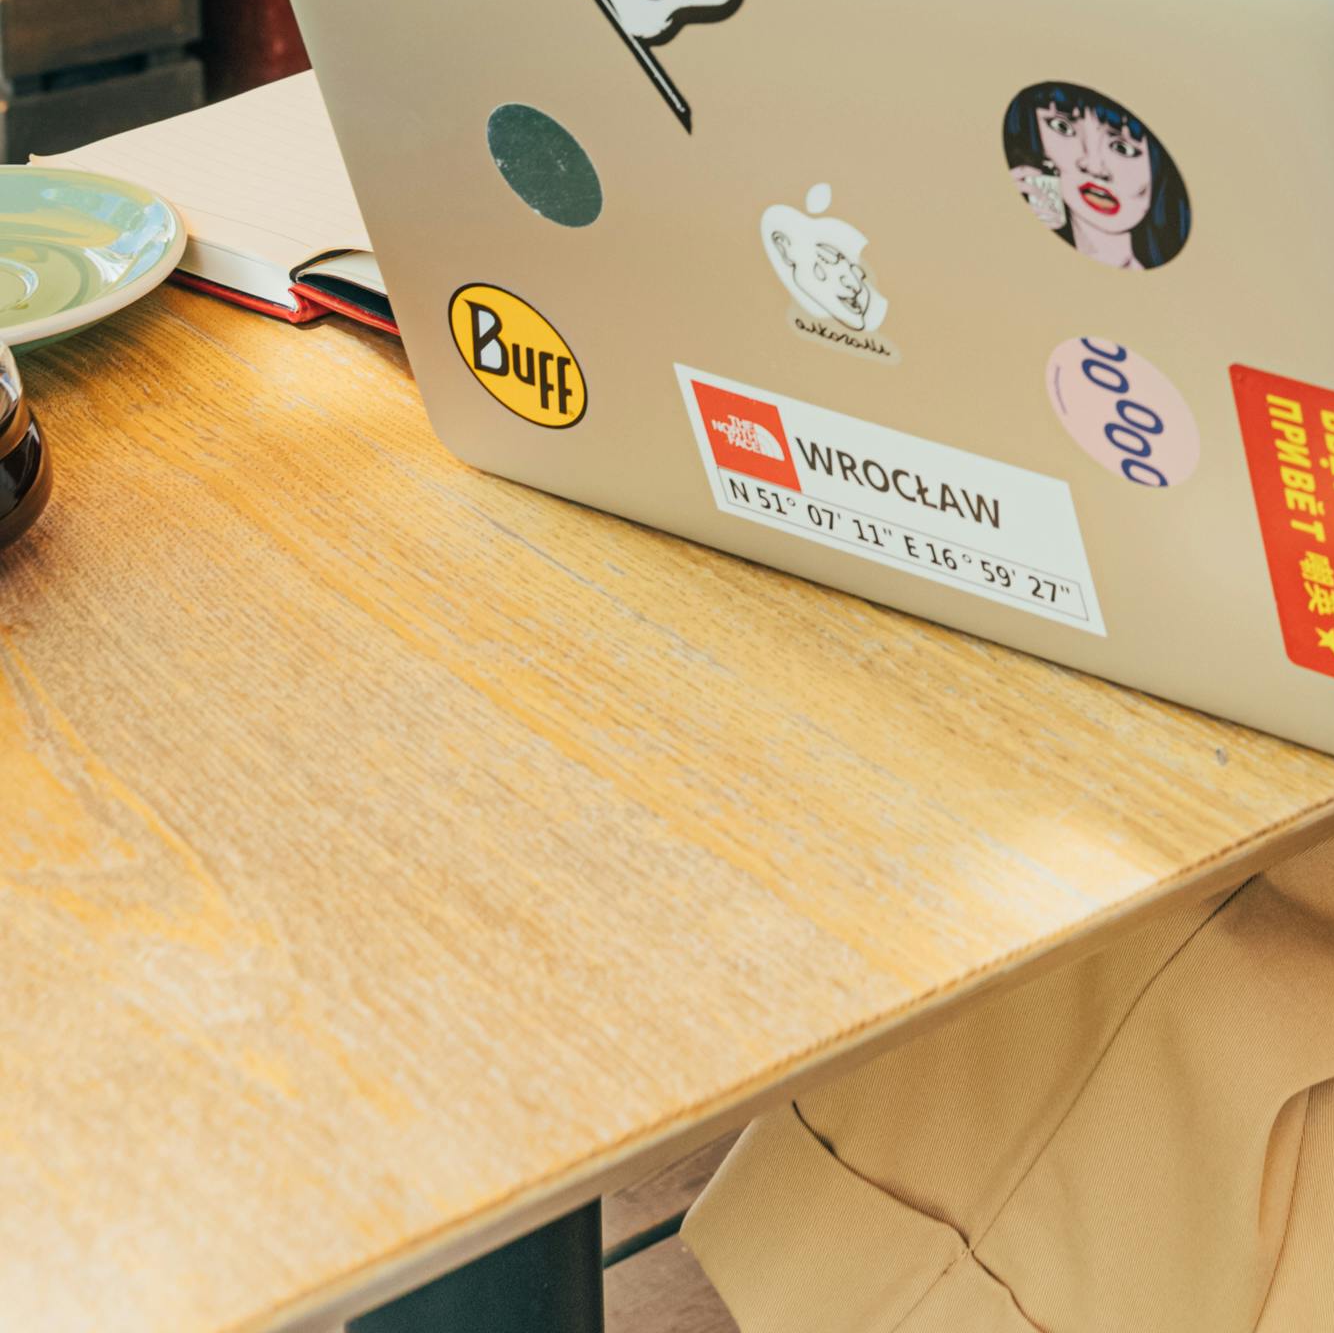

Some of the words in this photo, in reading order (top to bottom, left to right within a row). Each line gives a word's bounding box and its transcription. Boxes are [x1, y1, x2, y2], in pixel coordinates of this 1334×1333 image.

[729, 478, 750, 504] N
[756, 487, 796, 516] 51°
[904, 535, 921, 559] E
[796, 437, 1000, 529] WROCŁAW
